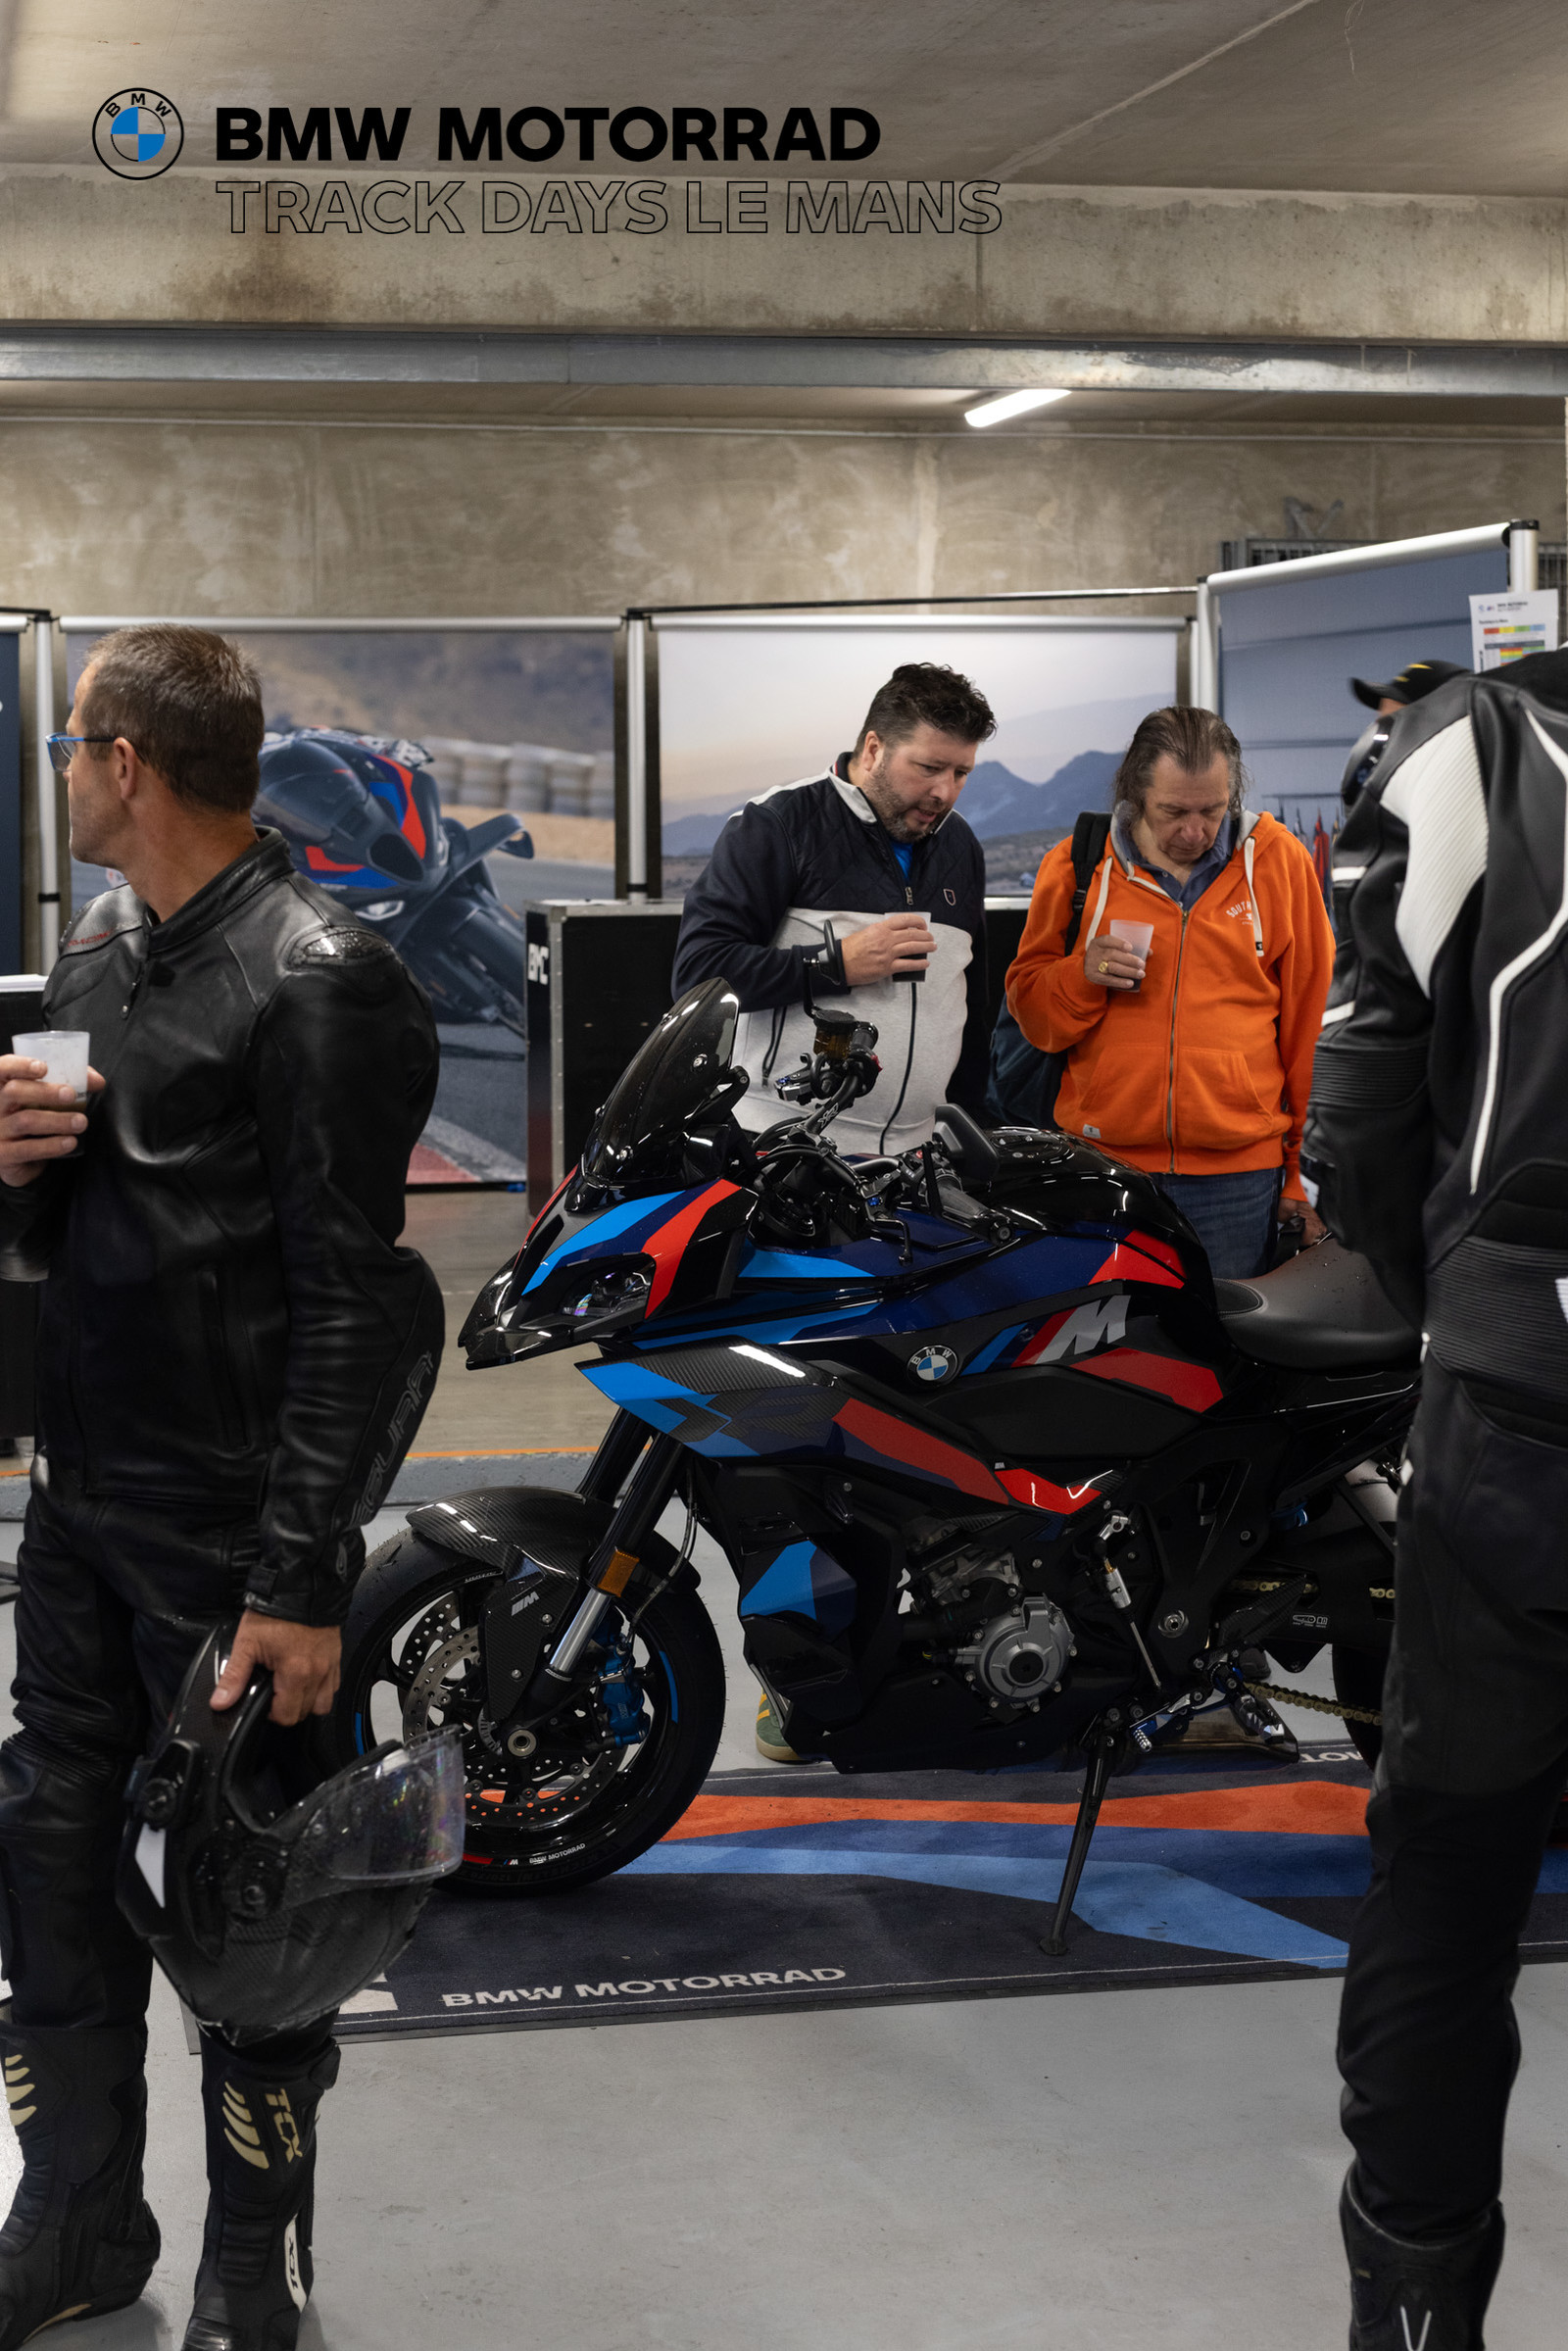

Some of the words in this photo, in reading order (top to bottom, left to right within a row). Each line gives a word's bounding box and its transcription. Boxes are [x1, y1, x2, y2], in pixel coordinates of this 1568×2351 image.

[910, 1347, 954, 1366] BMW
[548, 1842, 586, 1861] MOTORRAD
[441, 1984, 564, 2008] BMW
[574, 1966, 847, 1999] MOTORRAD
[265, 2087, 304, 2164] TCX
[288, 2236, 299, 2290] TCX
